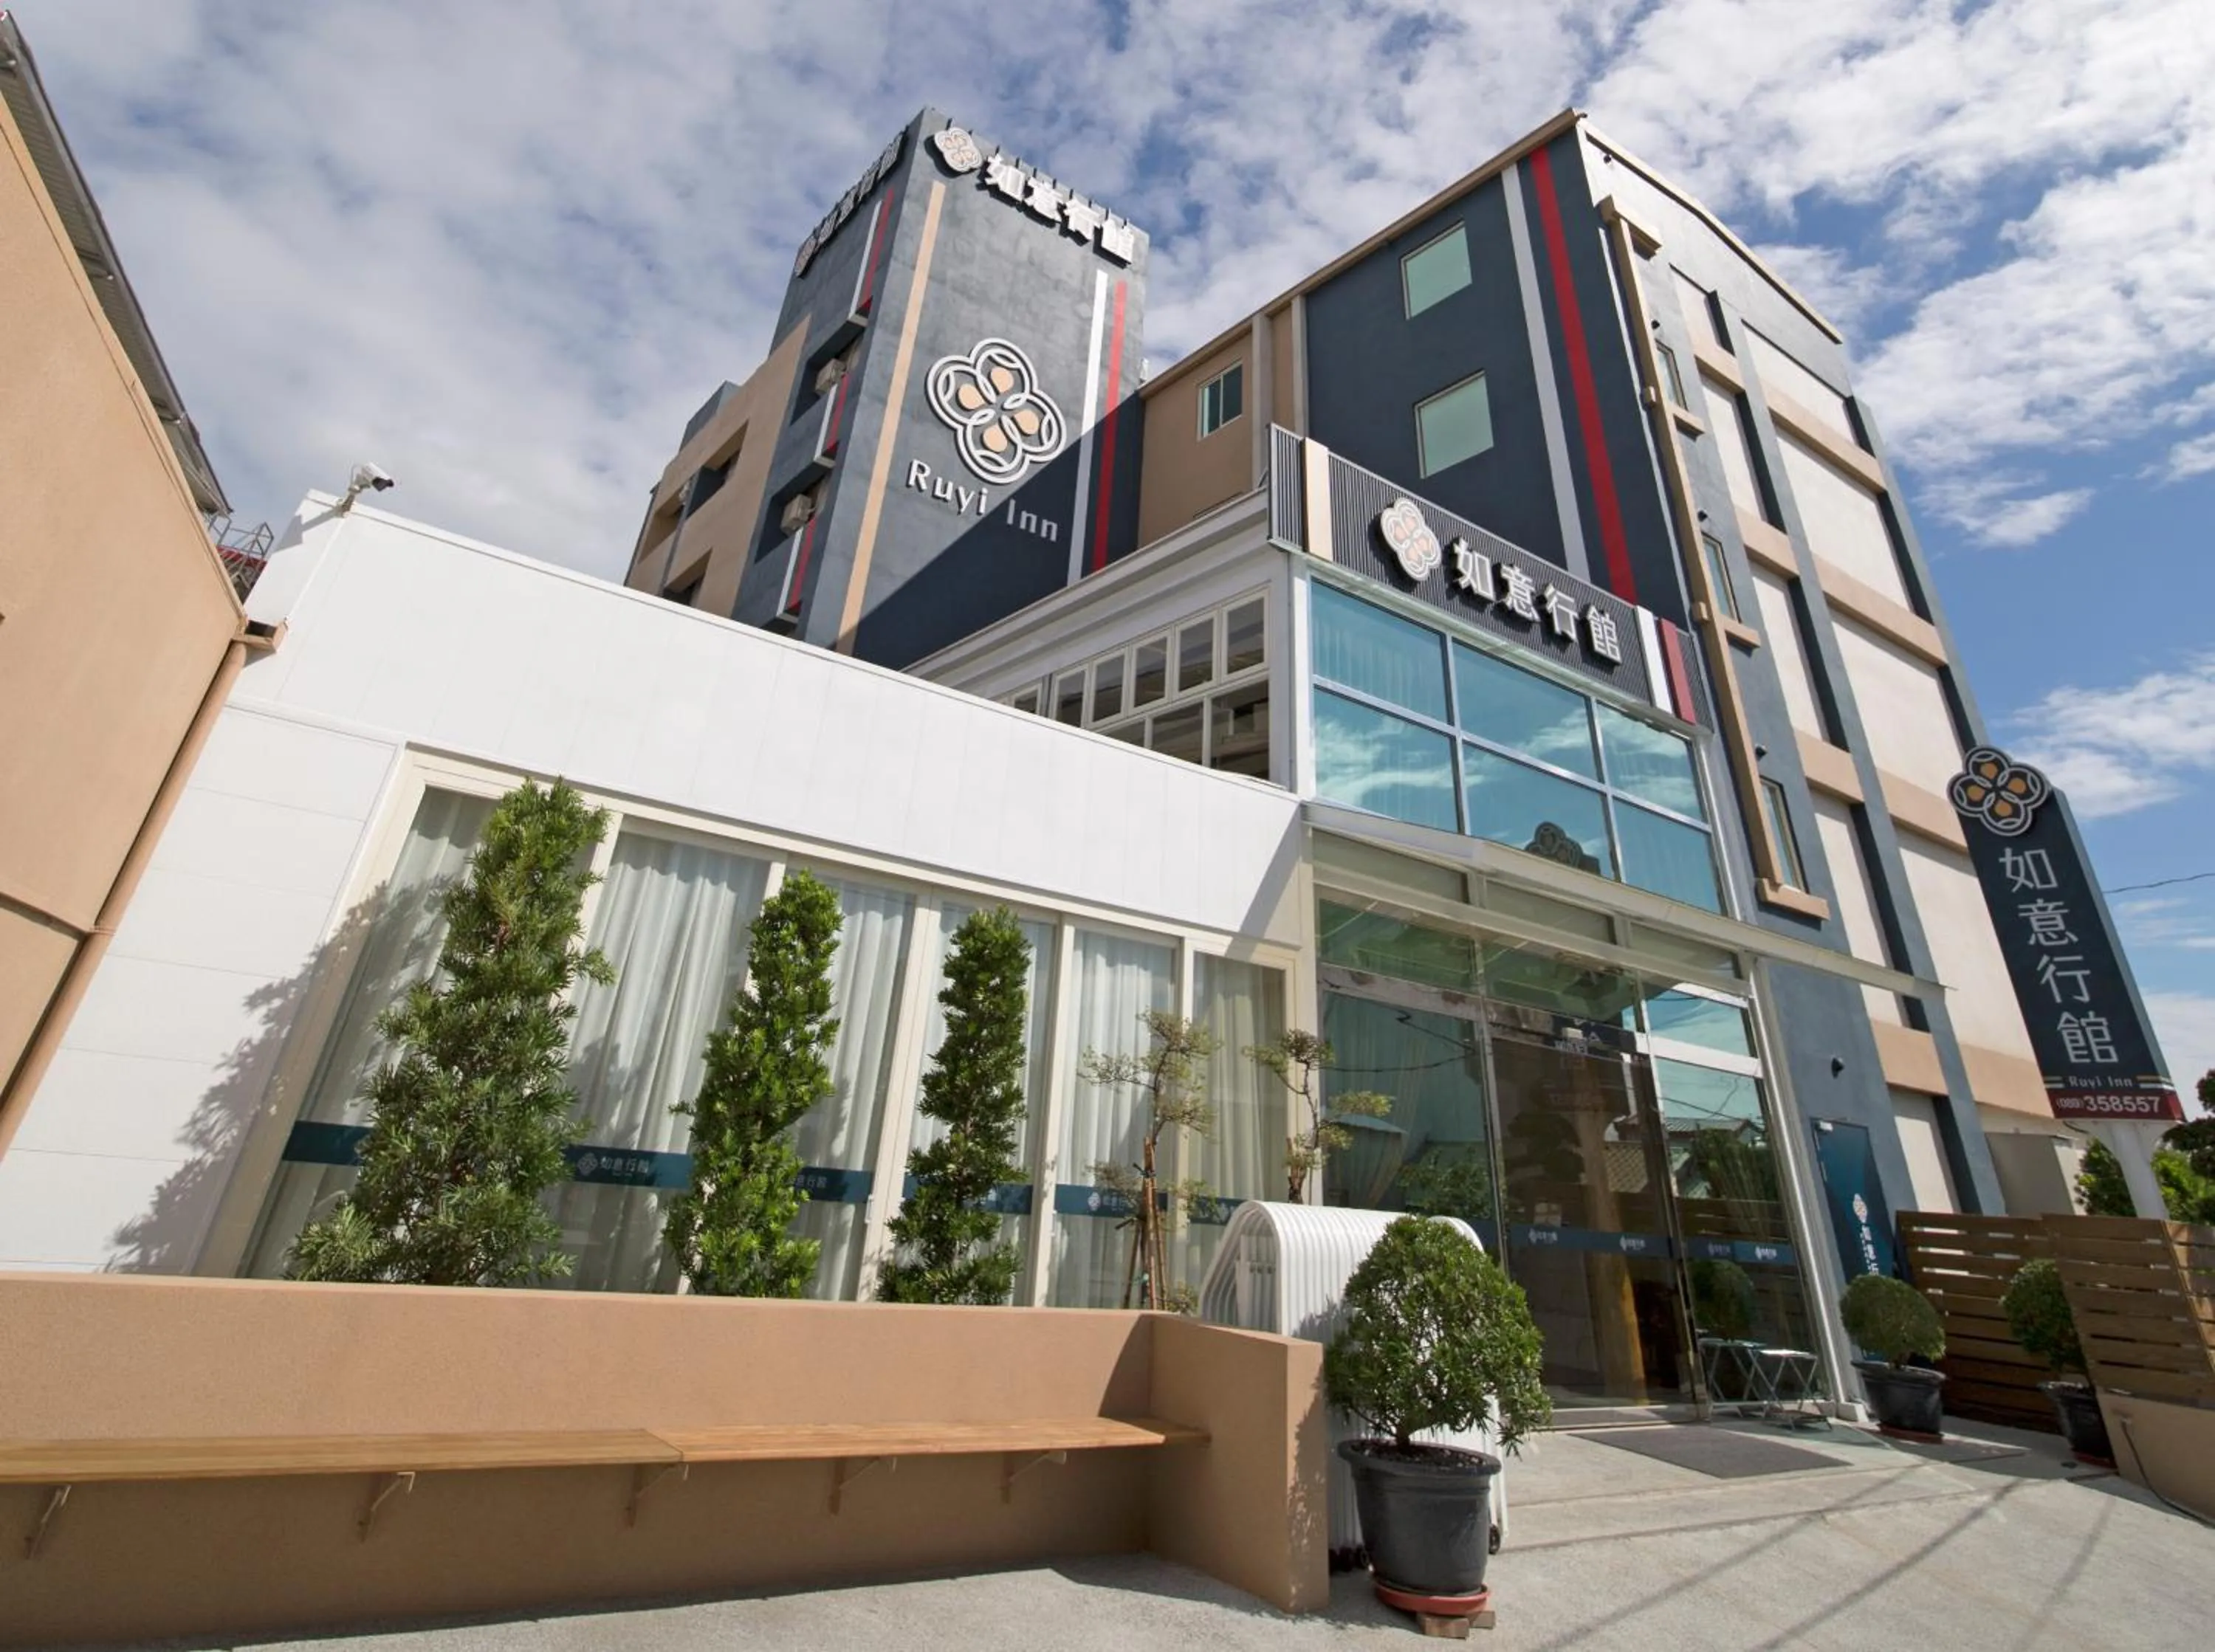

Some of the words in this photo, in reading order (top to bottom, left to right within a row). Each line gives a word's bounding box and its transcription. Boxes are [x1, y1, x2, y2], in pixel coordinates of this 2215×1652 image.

[907, 458, 989, 514] Ruyi
[1006, 498, 1059, 543] Inn
[1452, 538, 1623, 664] 如意行館
[1999, 847, 2119, 1064] 如意行館
[2068, 1075, 2102, 1089] Ruyi
[2107, 1075, 2133, 1087] Inn
